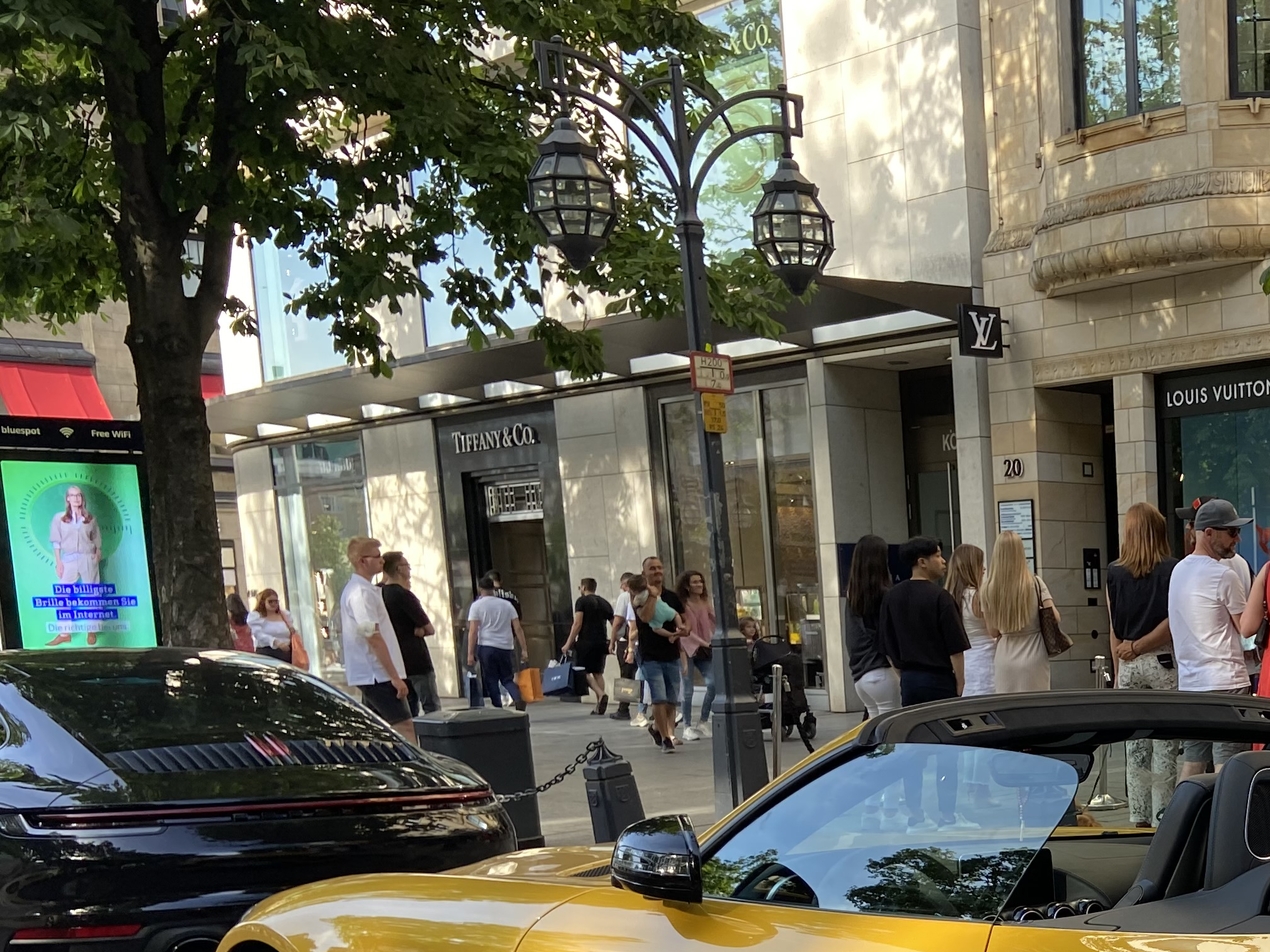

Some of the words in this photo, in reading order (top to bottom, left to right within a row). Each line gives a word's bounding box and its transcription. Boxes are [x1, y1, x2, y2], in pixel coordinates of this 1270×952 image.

[1166, 386, 1208, 408] LOUIS
[1, 426, 41, 437] bluespot
[91, 429, 110, 438] Free
[112, 430, 131, 439] WiFi
[1003, 458, 1024, 478] 20
[54, 585, 71, 594] Die
[72, 585, 114, 596] billigste
[35, 597, 64, 607] Brille
[66, 597, 119, 607] bekommen
[121, 597, 136, 607] Sie
[58, 609, 71, 619] im
